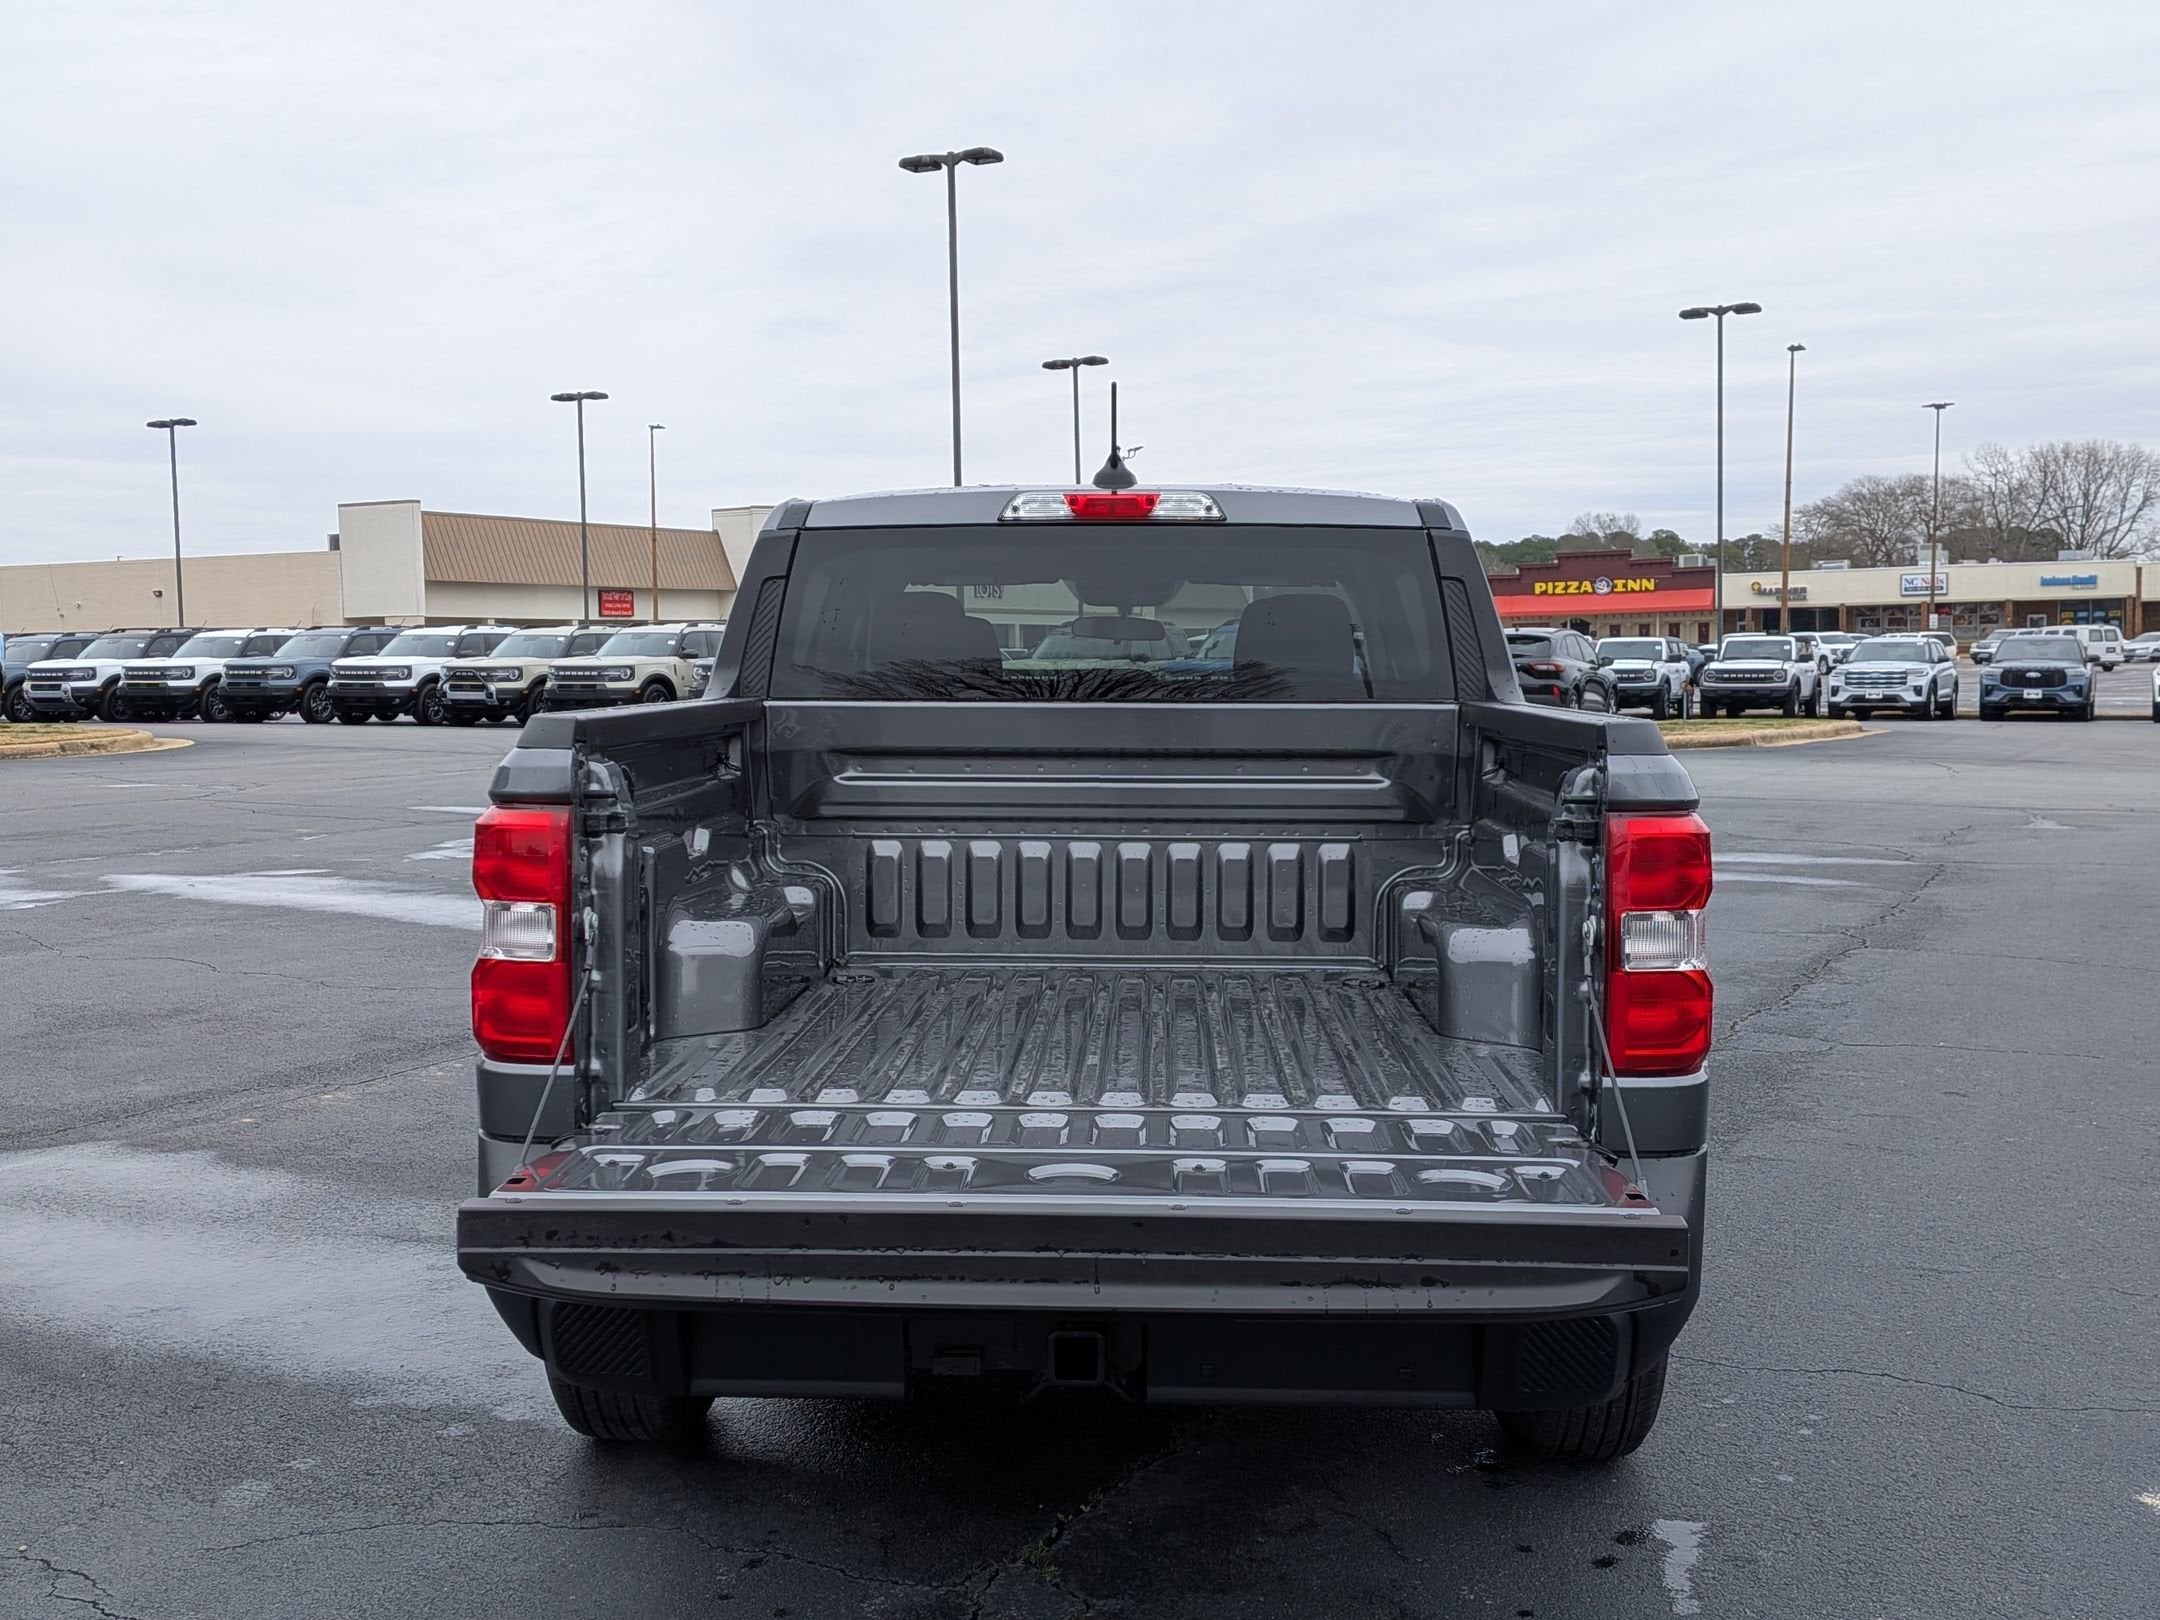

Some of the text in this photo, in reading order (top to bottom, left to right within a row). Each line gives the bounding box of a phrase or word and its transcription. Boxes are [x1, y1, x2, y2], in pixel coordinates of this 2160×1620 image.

[1534, 577, 1656, 595] PIZZA INN
[1904, 576, 1944, 586] NC Nals
